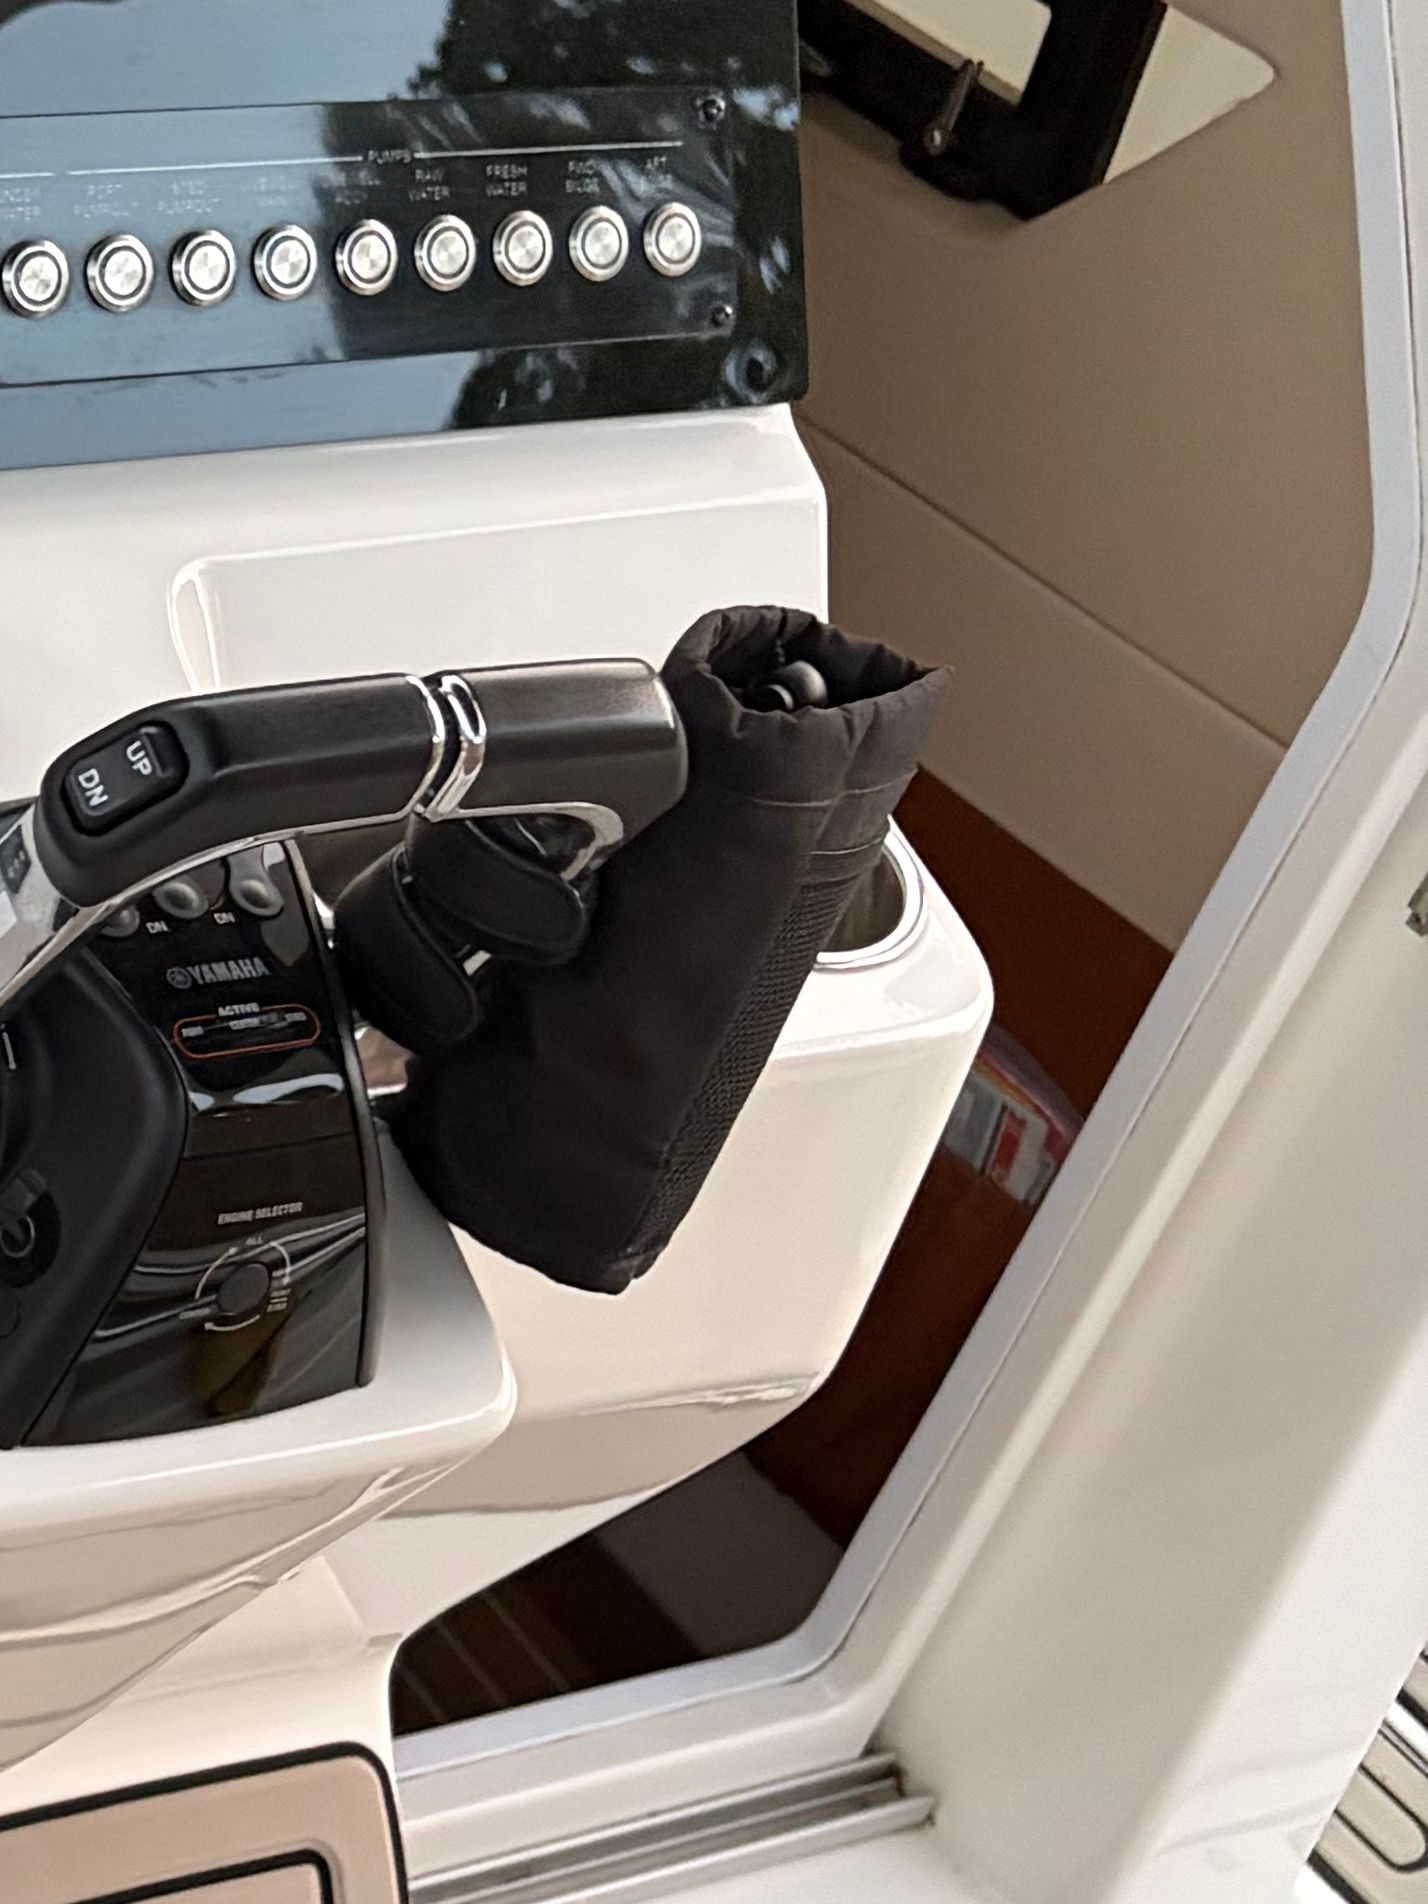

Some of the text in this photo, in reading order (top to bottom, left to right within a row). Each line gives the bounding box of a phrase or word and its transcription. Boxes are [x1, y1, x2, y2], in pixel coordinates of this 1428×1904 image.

[125, 741, 153, 776] UP
[78, 768, 109, 807] DN
[146, 920, 169, 934] DN
[213, 912, 236, 924] DN
[186, 956, 270, 985] YAMAHA
[218, 1002, 260, 1017] ACTIVE
